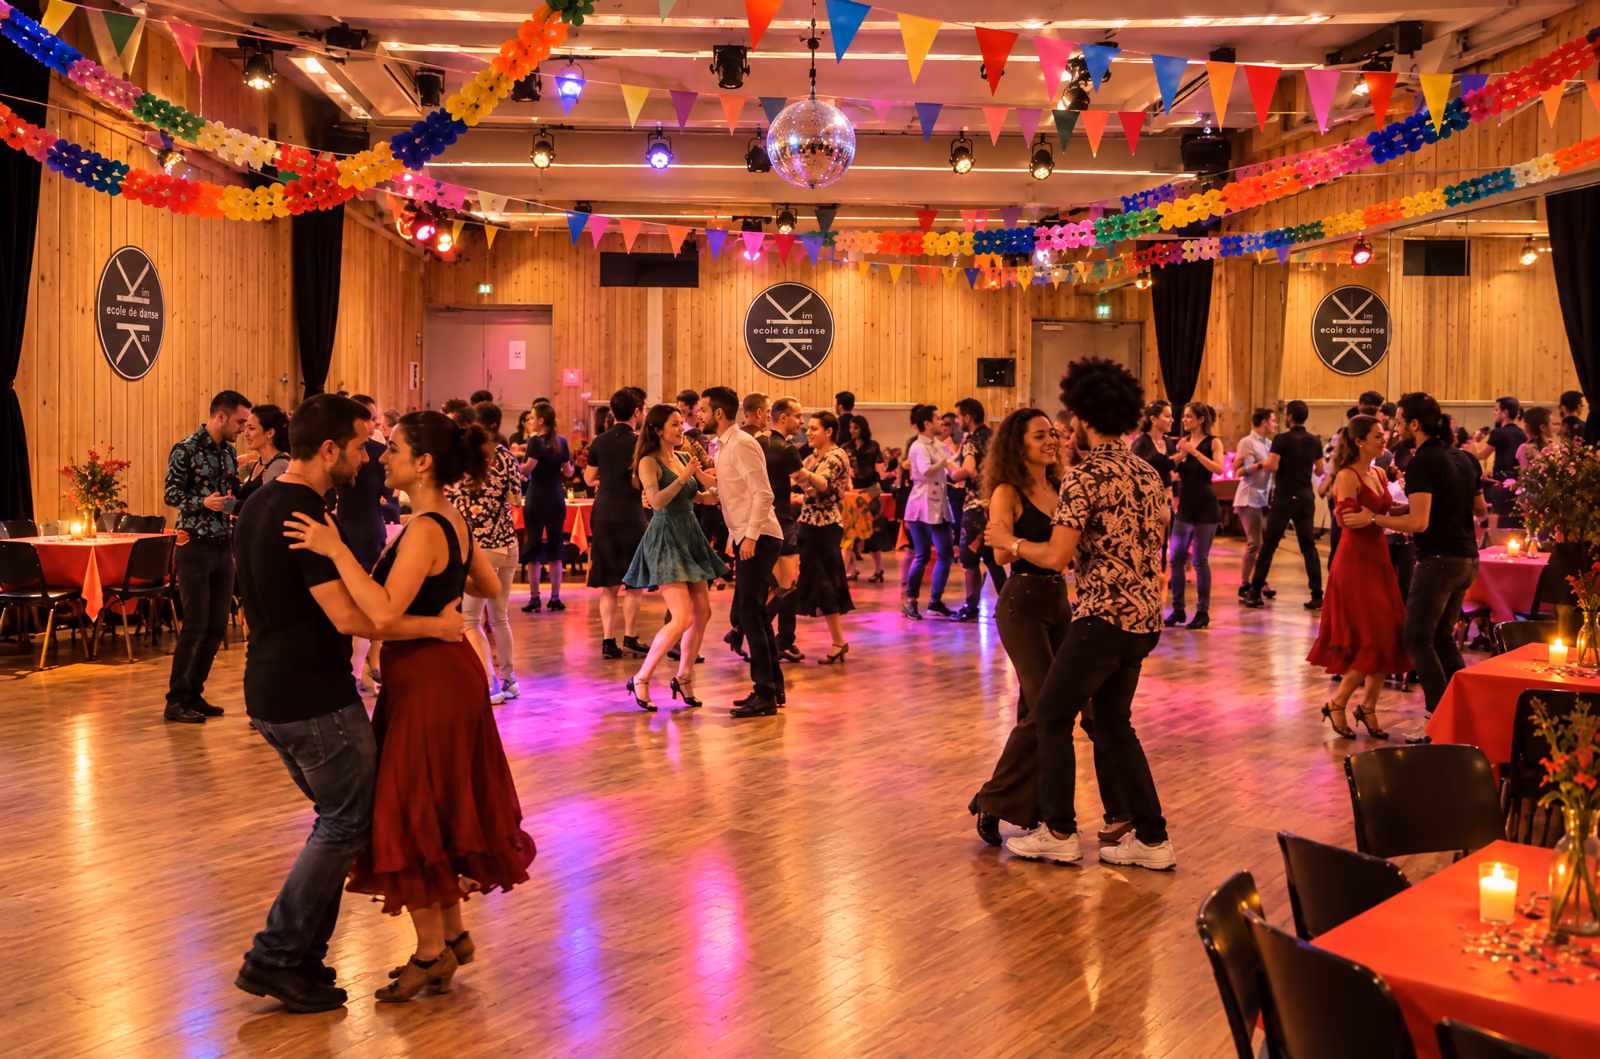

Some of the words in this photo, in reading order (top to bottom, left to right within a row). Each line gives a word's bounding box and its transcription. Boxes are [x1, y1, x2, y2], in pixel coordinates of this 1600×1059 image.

[106, 305, 127, 316] ecole
[128, 307, 138, 317] de
[139, 308, 160, 320] danse
[753, 327, 779, 335] ecole
[782, 327, 794, 335] de
[798, 327, 826, 335] danse
[1320, 326, 1343, 334] ecole
[1346, 326, 1357, 334] de
[1360, 326, 1385, 335] danse
